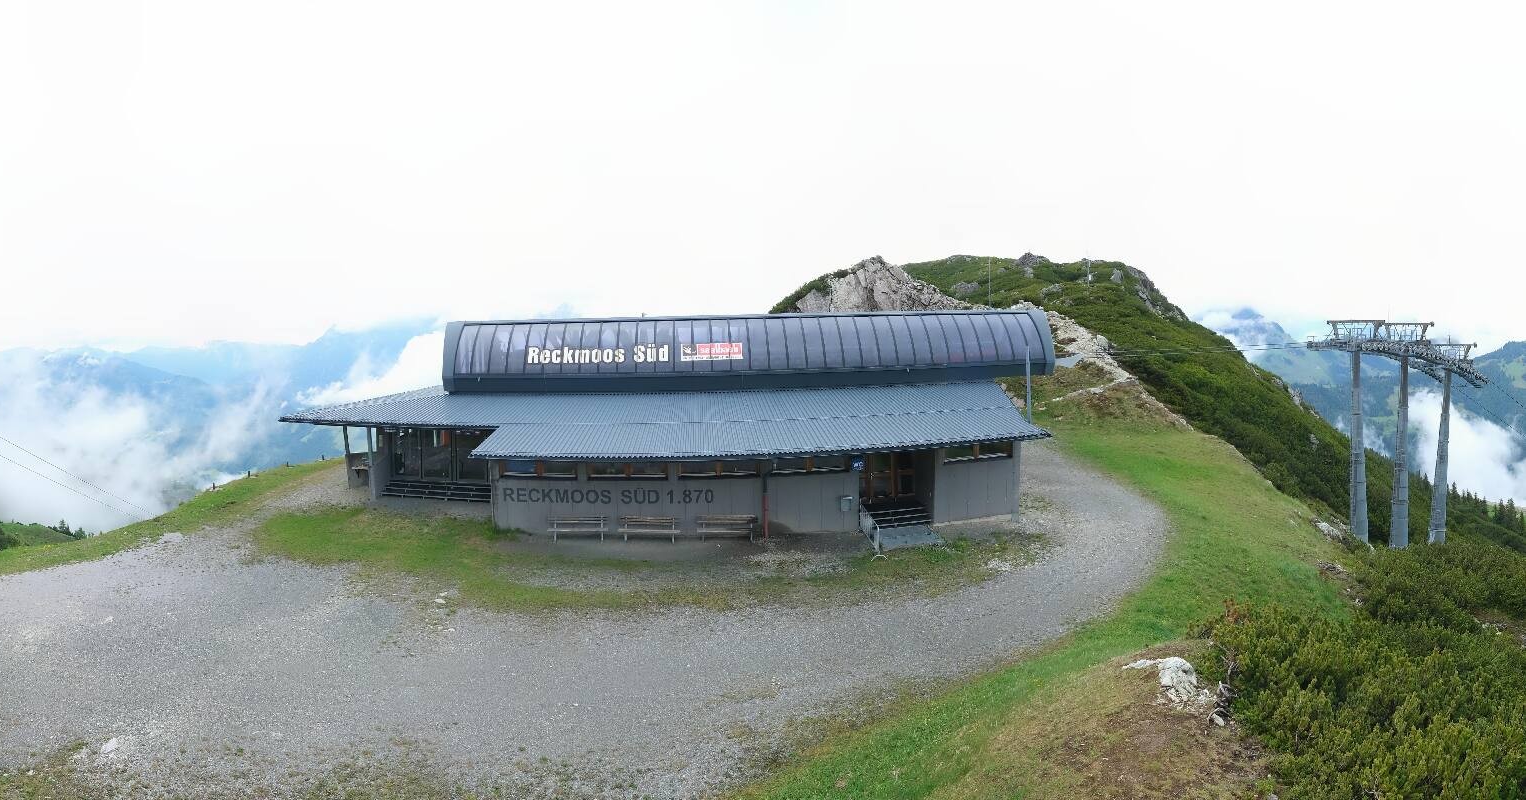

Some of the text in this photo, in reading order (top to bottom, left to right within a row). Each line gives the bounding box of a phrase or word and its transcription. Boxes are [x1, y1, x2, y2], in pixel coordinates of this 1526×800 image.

[527, 343, 669, 364] Reckmoos Süd
[503, 487, 714, 504] RECKMOOS SÜD 1.870
